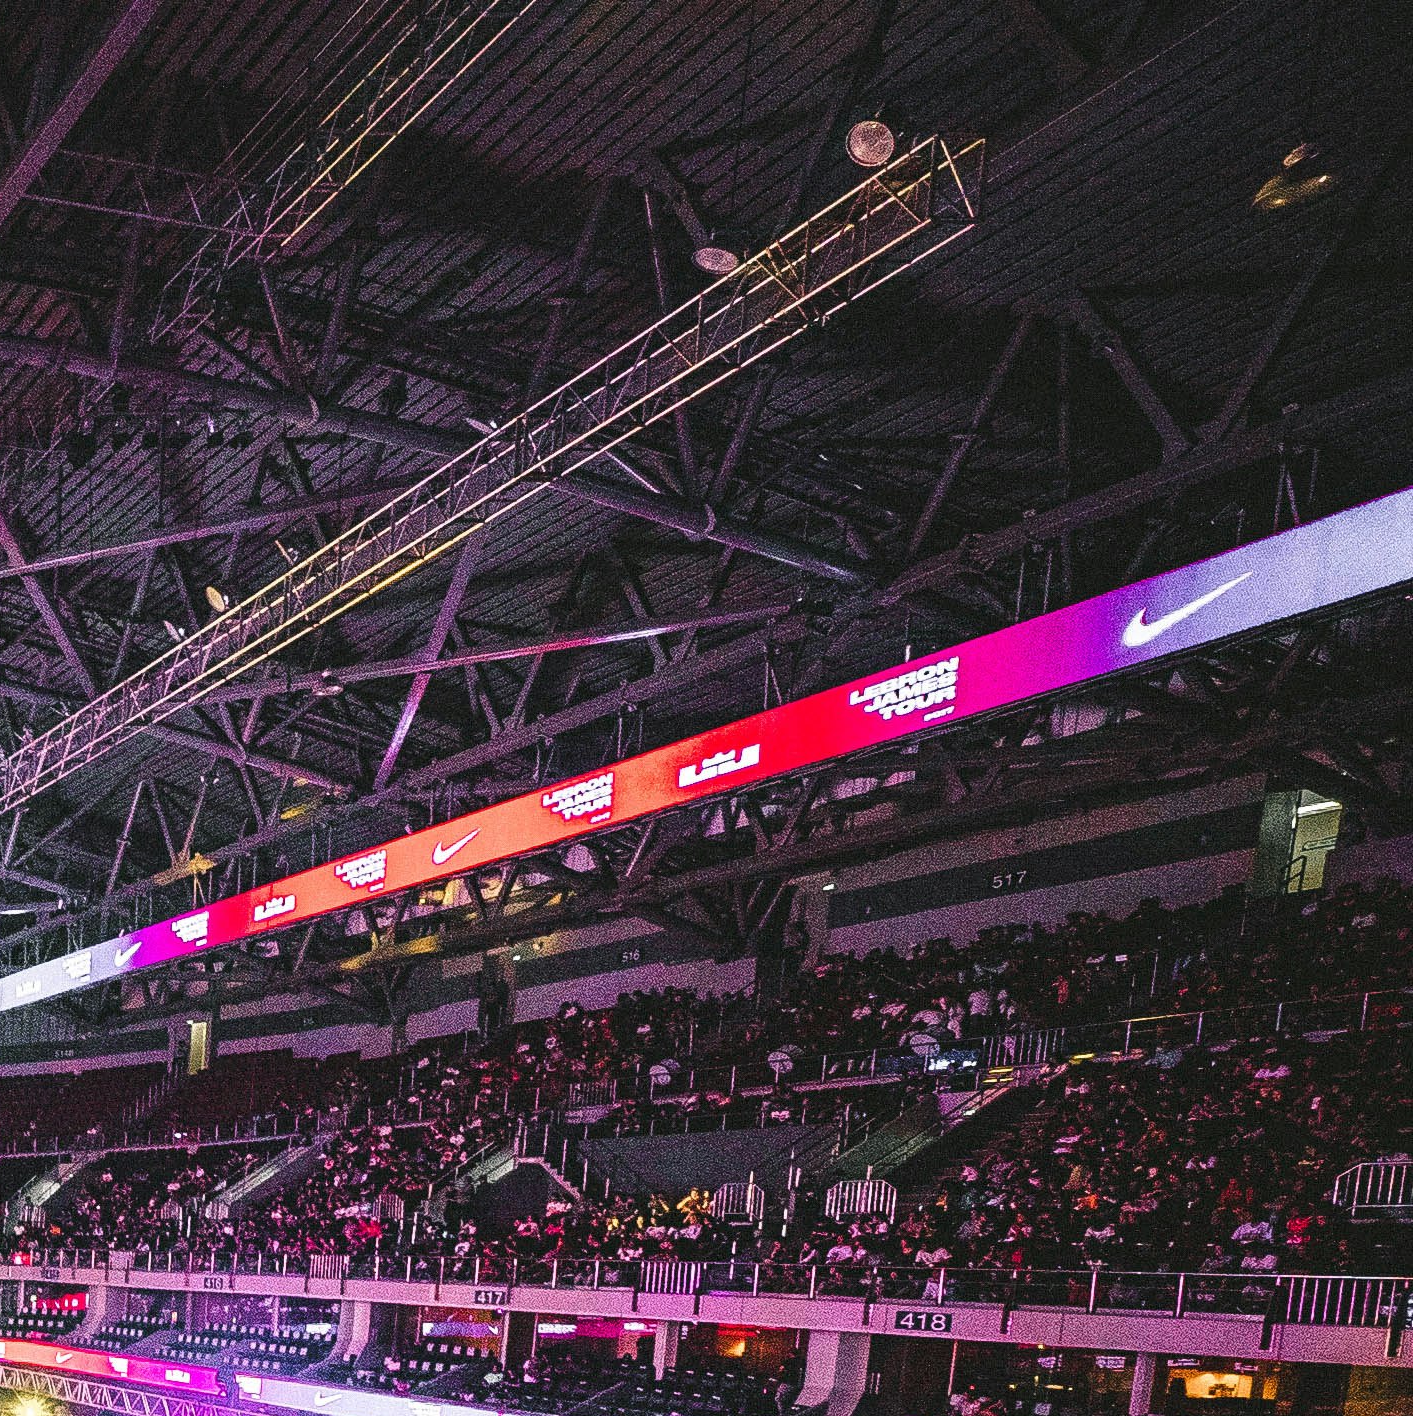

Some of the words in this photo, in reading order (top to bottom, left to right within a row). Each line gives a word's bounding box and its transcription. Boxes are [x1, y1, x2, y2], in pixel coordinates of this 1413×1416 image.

[849, 656, 959, 705] LEBRON
[864, 672, 958, 712] JAMES
[878, 686, 956, 720] TOUR
[543, 773, 613, 806] LEBRON
[562, 795, 611, 819] TOUR
[992, 870, 1027, 889] 517
[622, 949, 640, 963] 516
[477, 1292, 503, 1304] 417
[899, 1313, 947, 1331] 418
